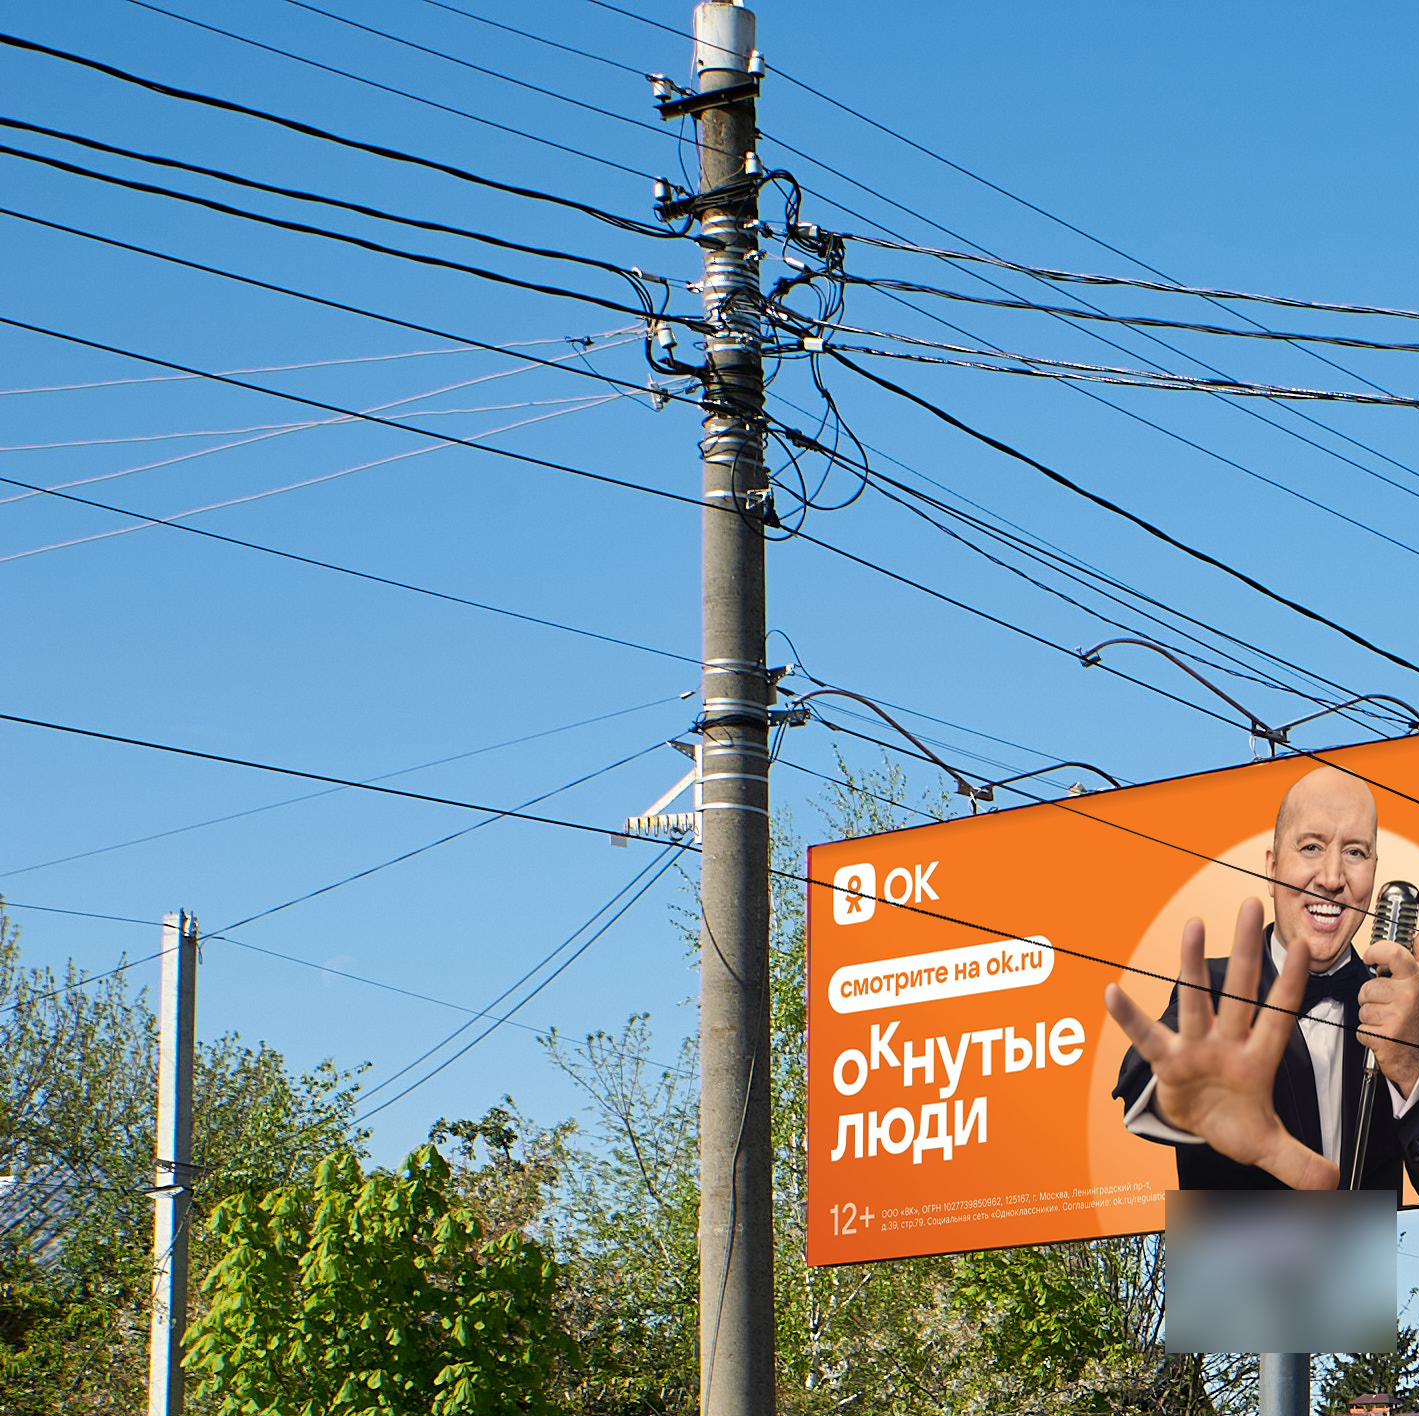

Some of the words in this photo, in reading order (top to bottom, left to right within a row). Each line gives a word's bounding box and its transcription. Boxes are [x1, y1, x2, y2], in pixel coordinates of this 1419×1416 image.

[840, 966, 949, 998] смотрите
[954, 960, 980, 980] на
[986, 950, 1043, 976] ok.ru
[831, 1096, 987, 1164] люди
[921, 1203, 942, 1214] ОГРН
[1005, 1194, 1031, 1205] 125167,
[1039, 1190, 1070, 1201] Москва,
[1072, 1182, 1132, 1197] Ленинградский
[926, 1213, 971, 1226] Социальная
[972, 1212, 989, 1221] сеть
[1062, 1199, 1112, 1211] Соглашение:
[830, 1202, 875, 1235] 12+
